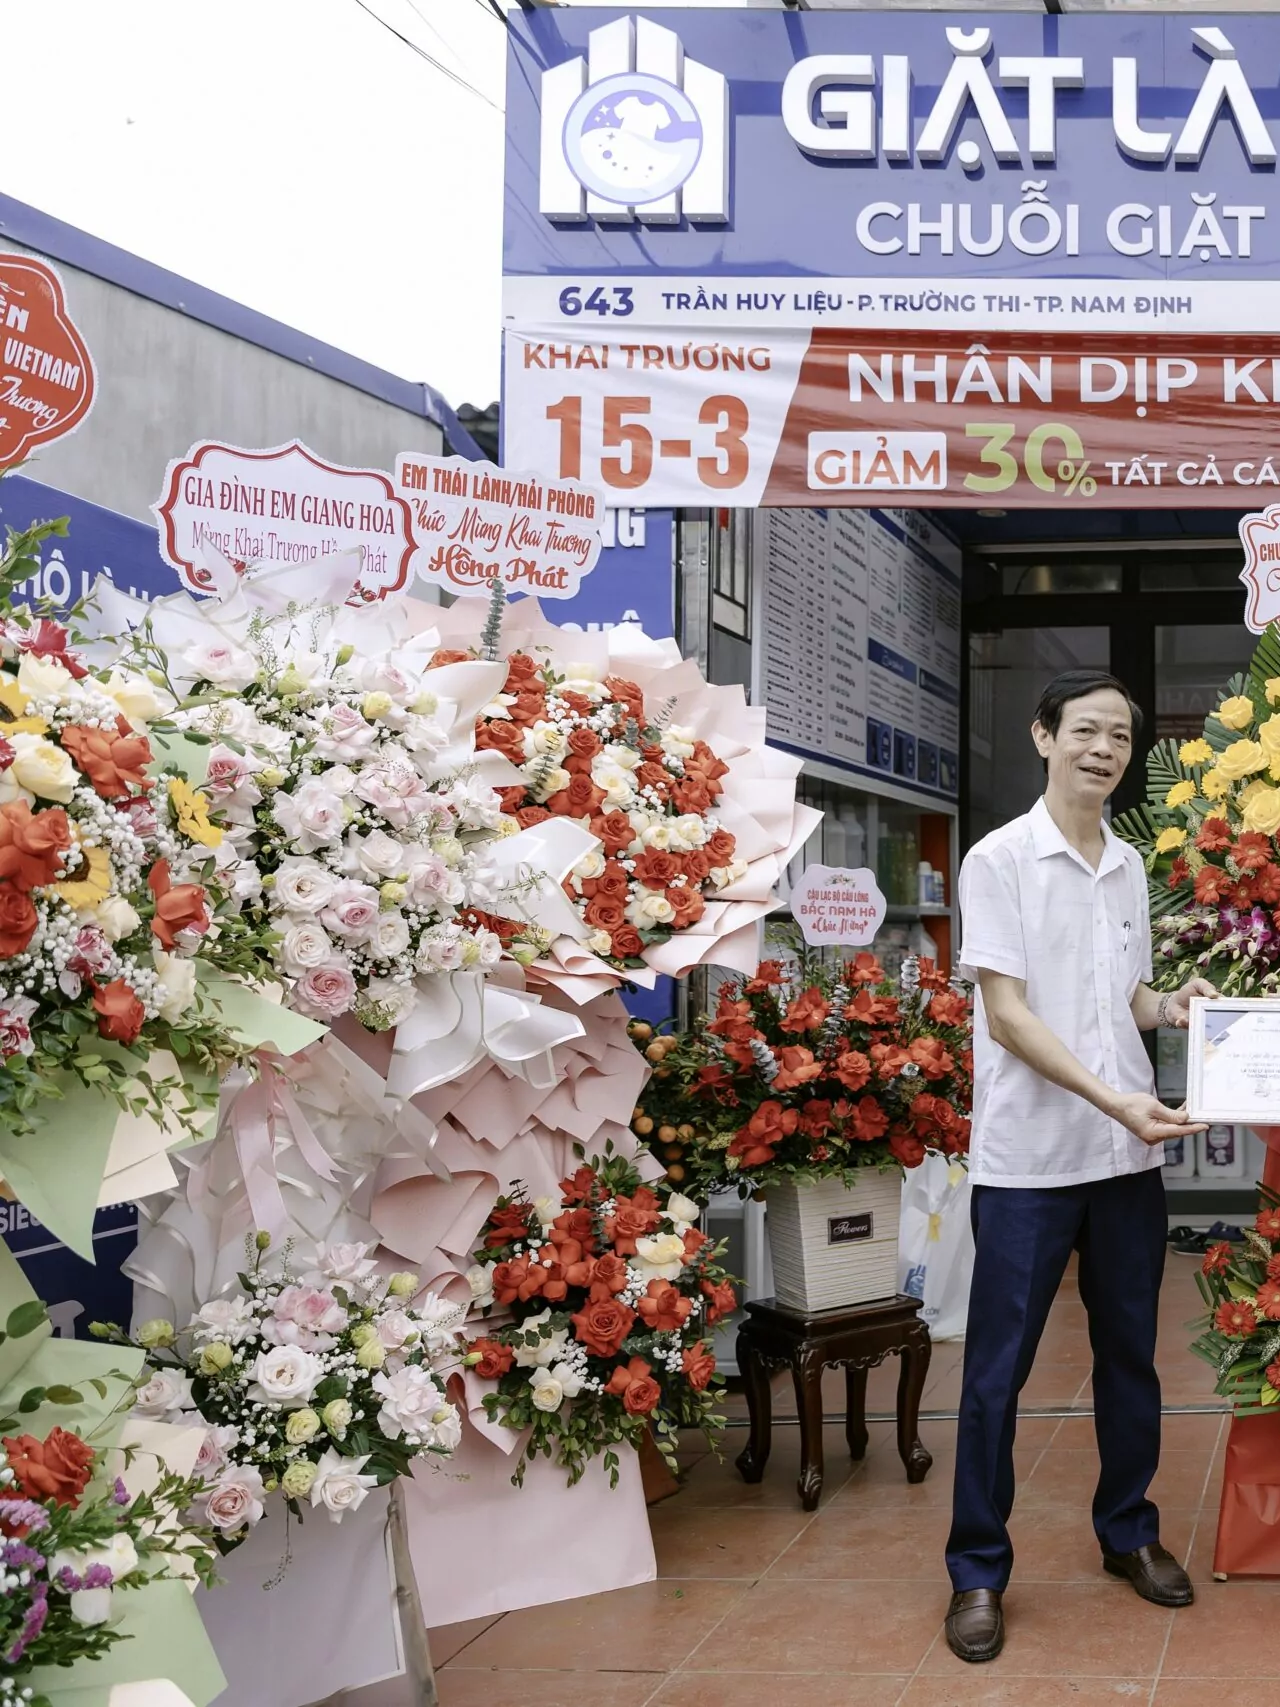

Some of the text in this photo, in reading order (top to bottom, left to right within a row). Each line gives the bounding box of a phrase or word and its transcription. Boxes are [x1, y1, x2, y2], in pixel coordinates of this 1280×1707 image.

[781, 27, 1085, 171] GIẶT
[1112, 27, 1277, 164] LÀ
[855, 180, 1080, 257] CHUỖI
[1106, 192, 1265, 261] GIẶT
[558, 286, 635, 317] 643
[661, 286, 727, 312] TRẦN
[736, 293, 787, 311] HUY
[794, 291, 842, 315] LIỆU
[858, 294, 876, 312] P.
[880, 290, 976, 313] TRƯỜNG
[983, 294, 1021, 313] THI
[1071, 296, 1126, 314] NAM
[1133, 296, 1193, 318] ĐỊNH
[4, 337, 81, 392] VIETNAM
[523, 341, 772, 374] KHAI TRƯƠNG
[849, 343, 1053, 404] NHÂN
[1080, 357, 1198, 418] DỊP
[546, 394, 751, 490] 15-3
[815, 433, 942, 488] GIẢM
[963, 421, 1098, 498] 30%
[1104, 453, 1168, 487] TẤT
[1176, 453, 1224, 487] CẢ
[184, 475, 396, 535] GIA ĐÌNH EM GIANG HOA
[401, 462, 596, 519] EM THÁI LÀNH/HẢI PHÒNG
[234, 527, 265, 558] Khai
[504, 512, 543, 551] Khai
[428, 543, 569, 590] Hồng Phát
[800, 900, 877, 917] BẮC NAM HÀ
[832, 1221, 869, 1236] Flowers
